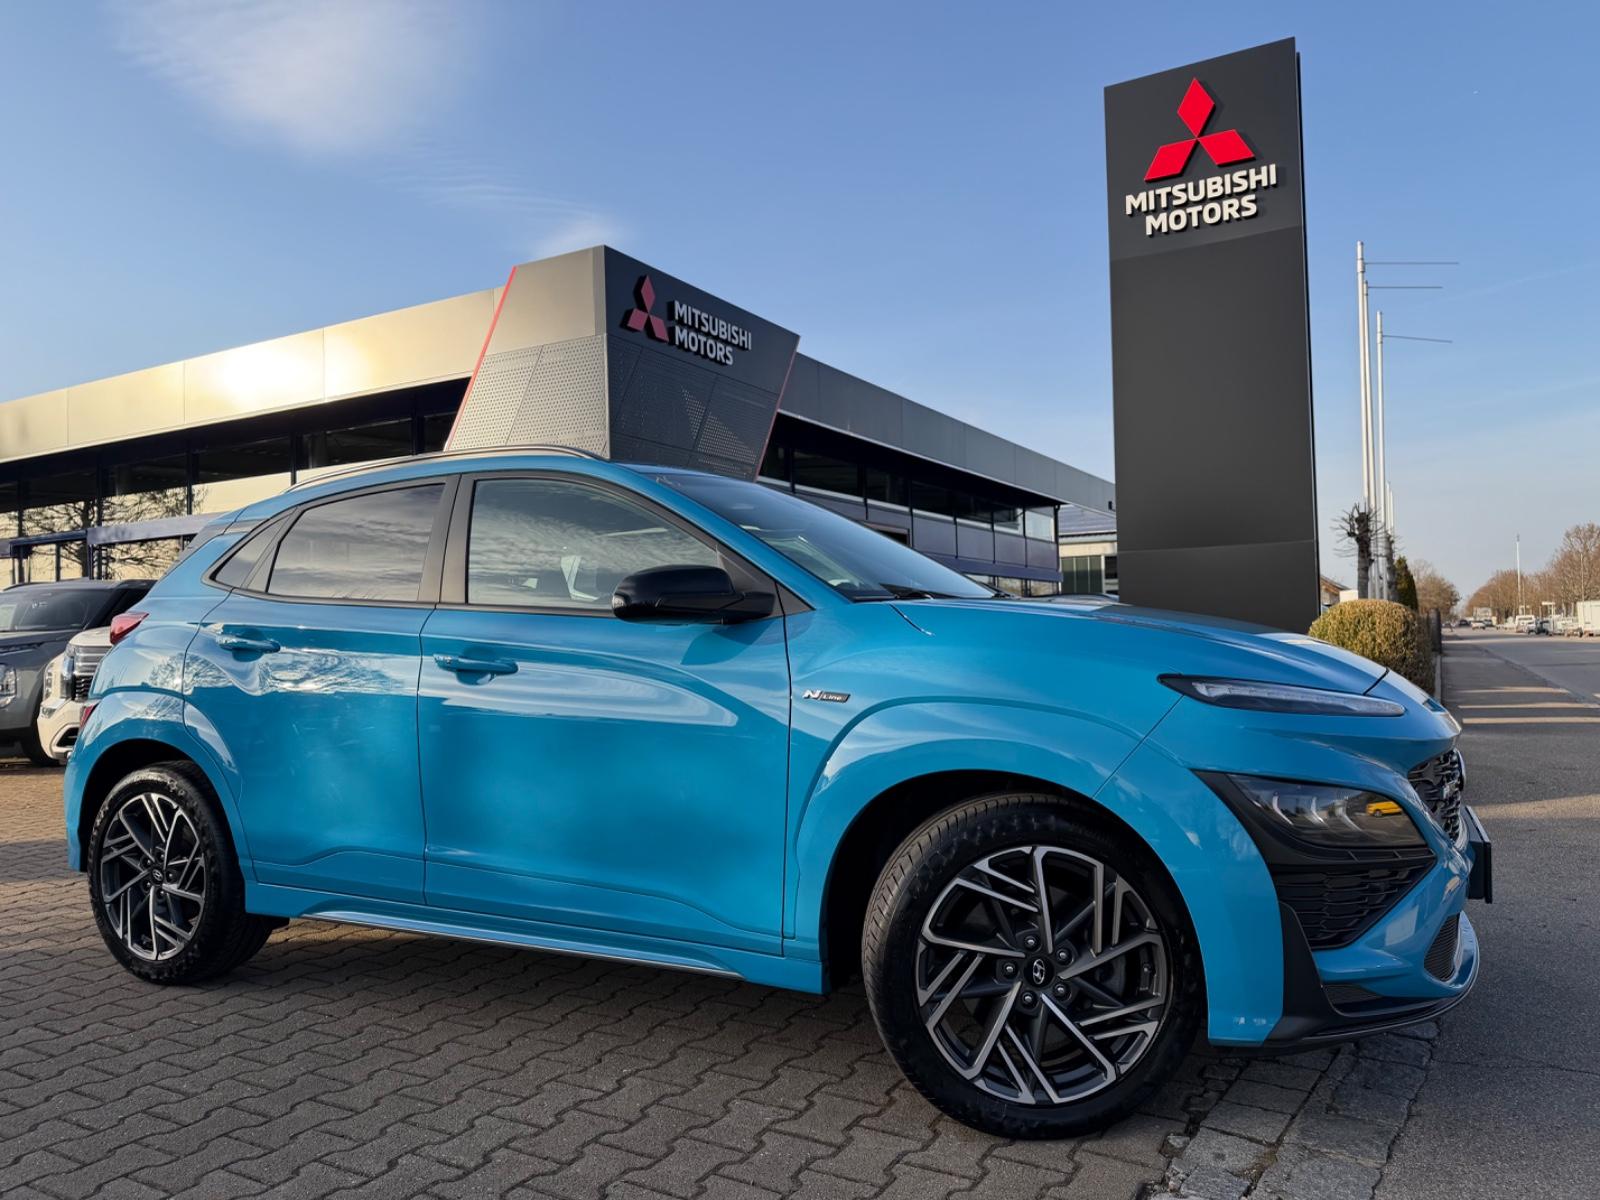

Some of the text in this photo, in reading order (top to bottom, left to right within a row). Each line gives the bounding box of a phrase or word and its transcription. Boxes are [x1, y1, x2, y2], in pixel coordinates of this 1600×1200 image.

[1126, 164, 1276, 214] MITSUBISHI
[1145, 195, 1257, 235] MOTORS
[674, 300, 752, 350] MITSUBISHI
[675, 325, 734, 365] MOTORS
[803, 689, 821, 700] N
